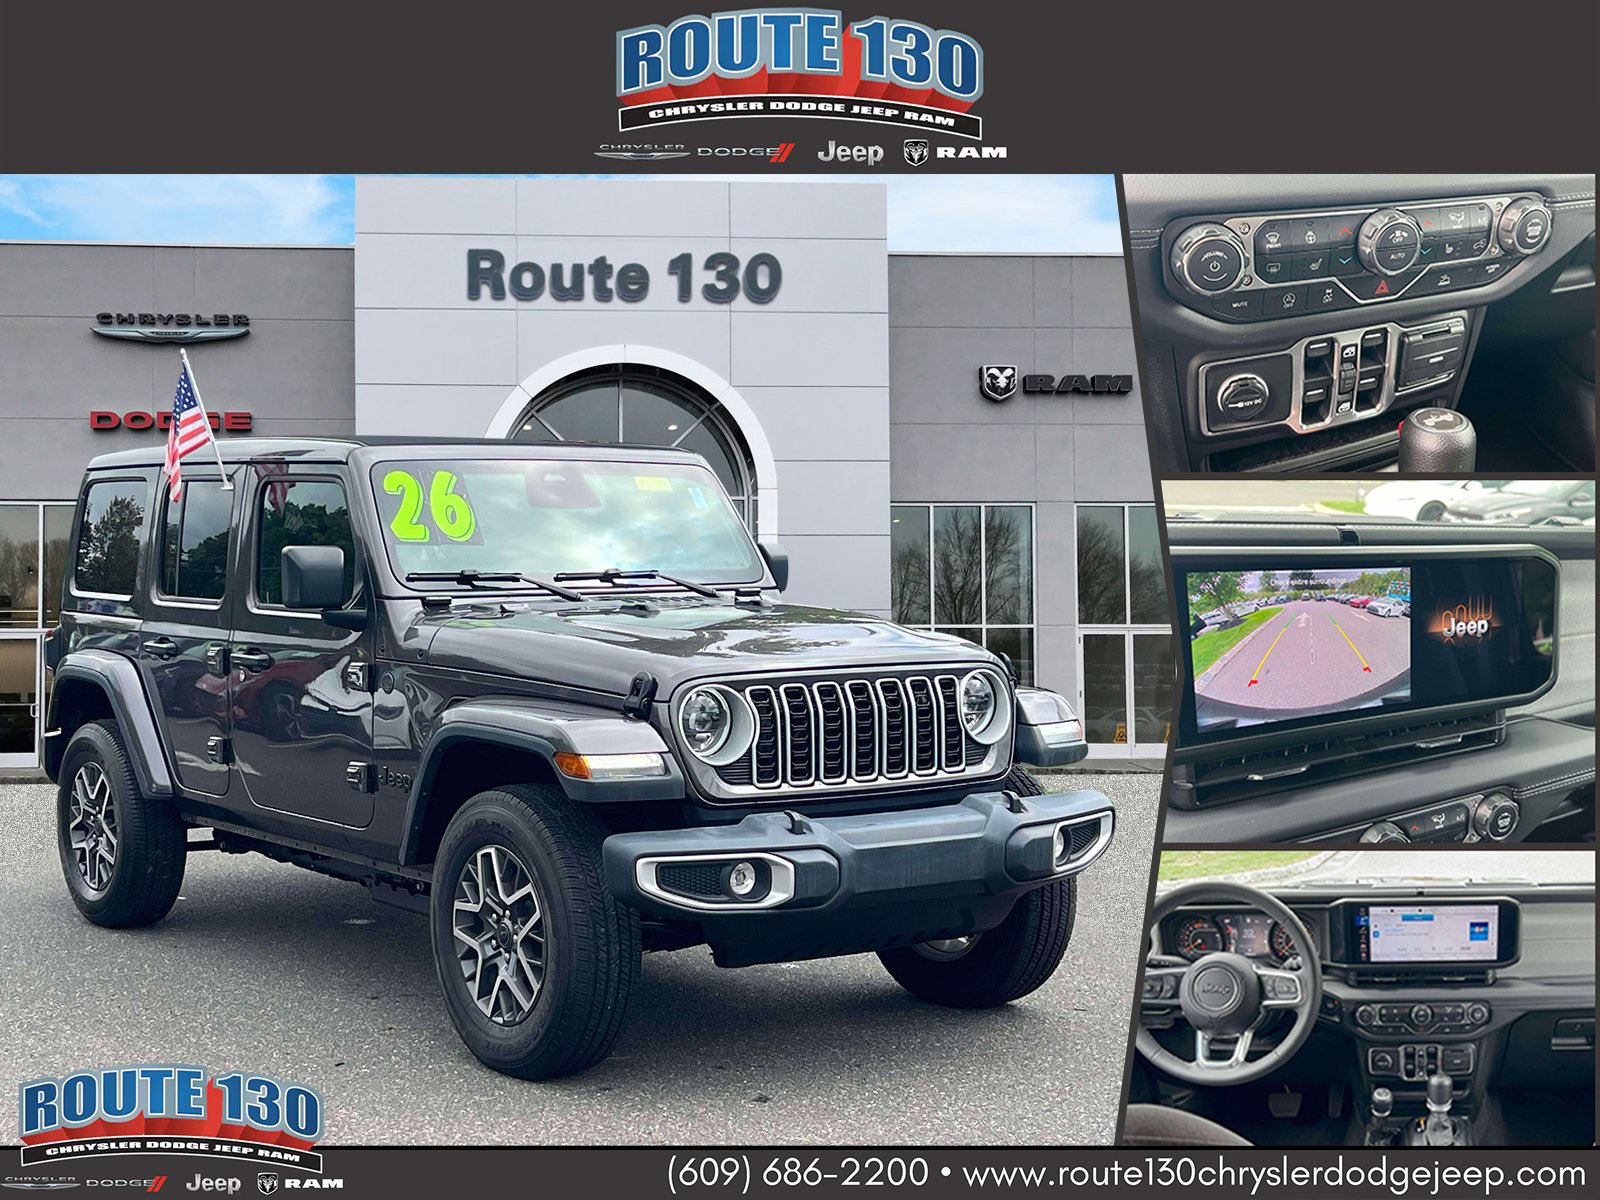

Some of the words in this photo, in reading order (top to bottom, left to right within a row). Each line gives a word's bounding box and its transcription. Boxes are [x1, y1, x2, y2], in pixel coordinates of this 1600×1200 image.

[467, 248, 650, 303] Route
[668, 252, 782, 304] 130
[96, 313, 250, 326] CHRYSLER
[1023, 374, 1133, 395] RAM
[383, 470, 476, 543] 26
[1442, 618, 1488, 637] Jeep
[378, 765, 412, 793] Jeep
